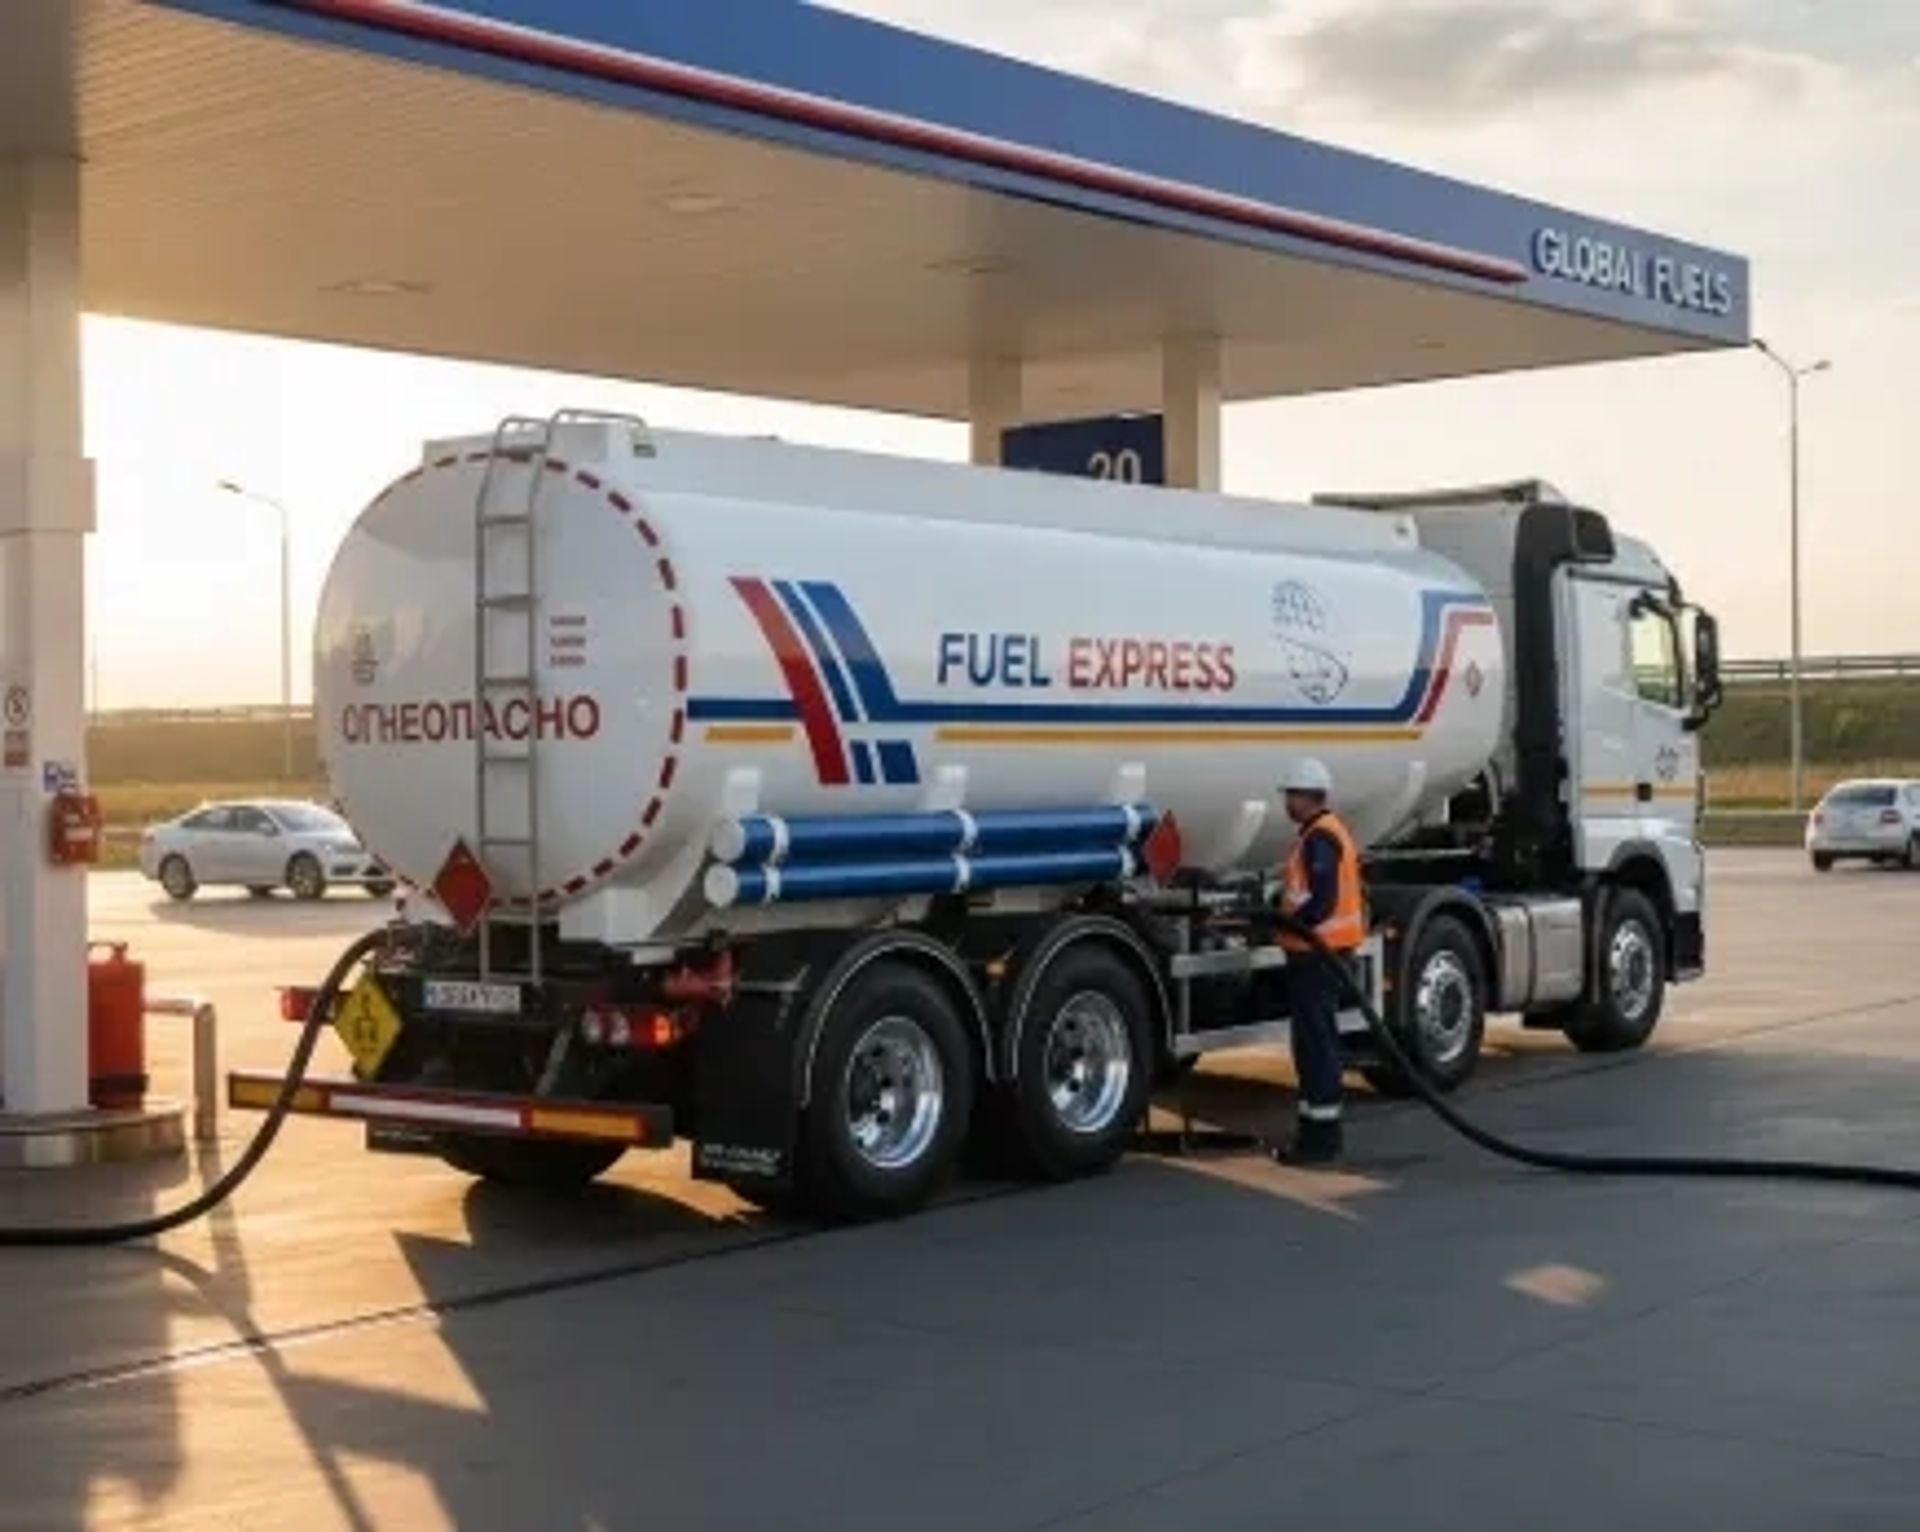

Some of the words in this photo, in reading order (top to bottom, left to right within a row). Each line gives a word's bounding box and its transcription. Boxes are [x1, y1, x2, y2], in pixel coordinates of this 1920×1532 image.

[1533, 228, 1645, 296] GLOBAL
[1650, 256, 1732, 316] FUELS
[937, 632, 1051, 687] FUEL
[1067, 638, 1237, 691] EXPRESS
[342, 695, 601, 743] ОГНЕОПАСНО
